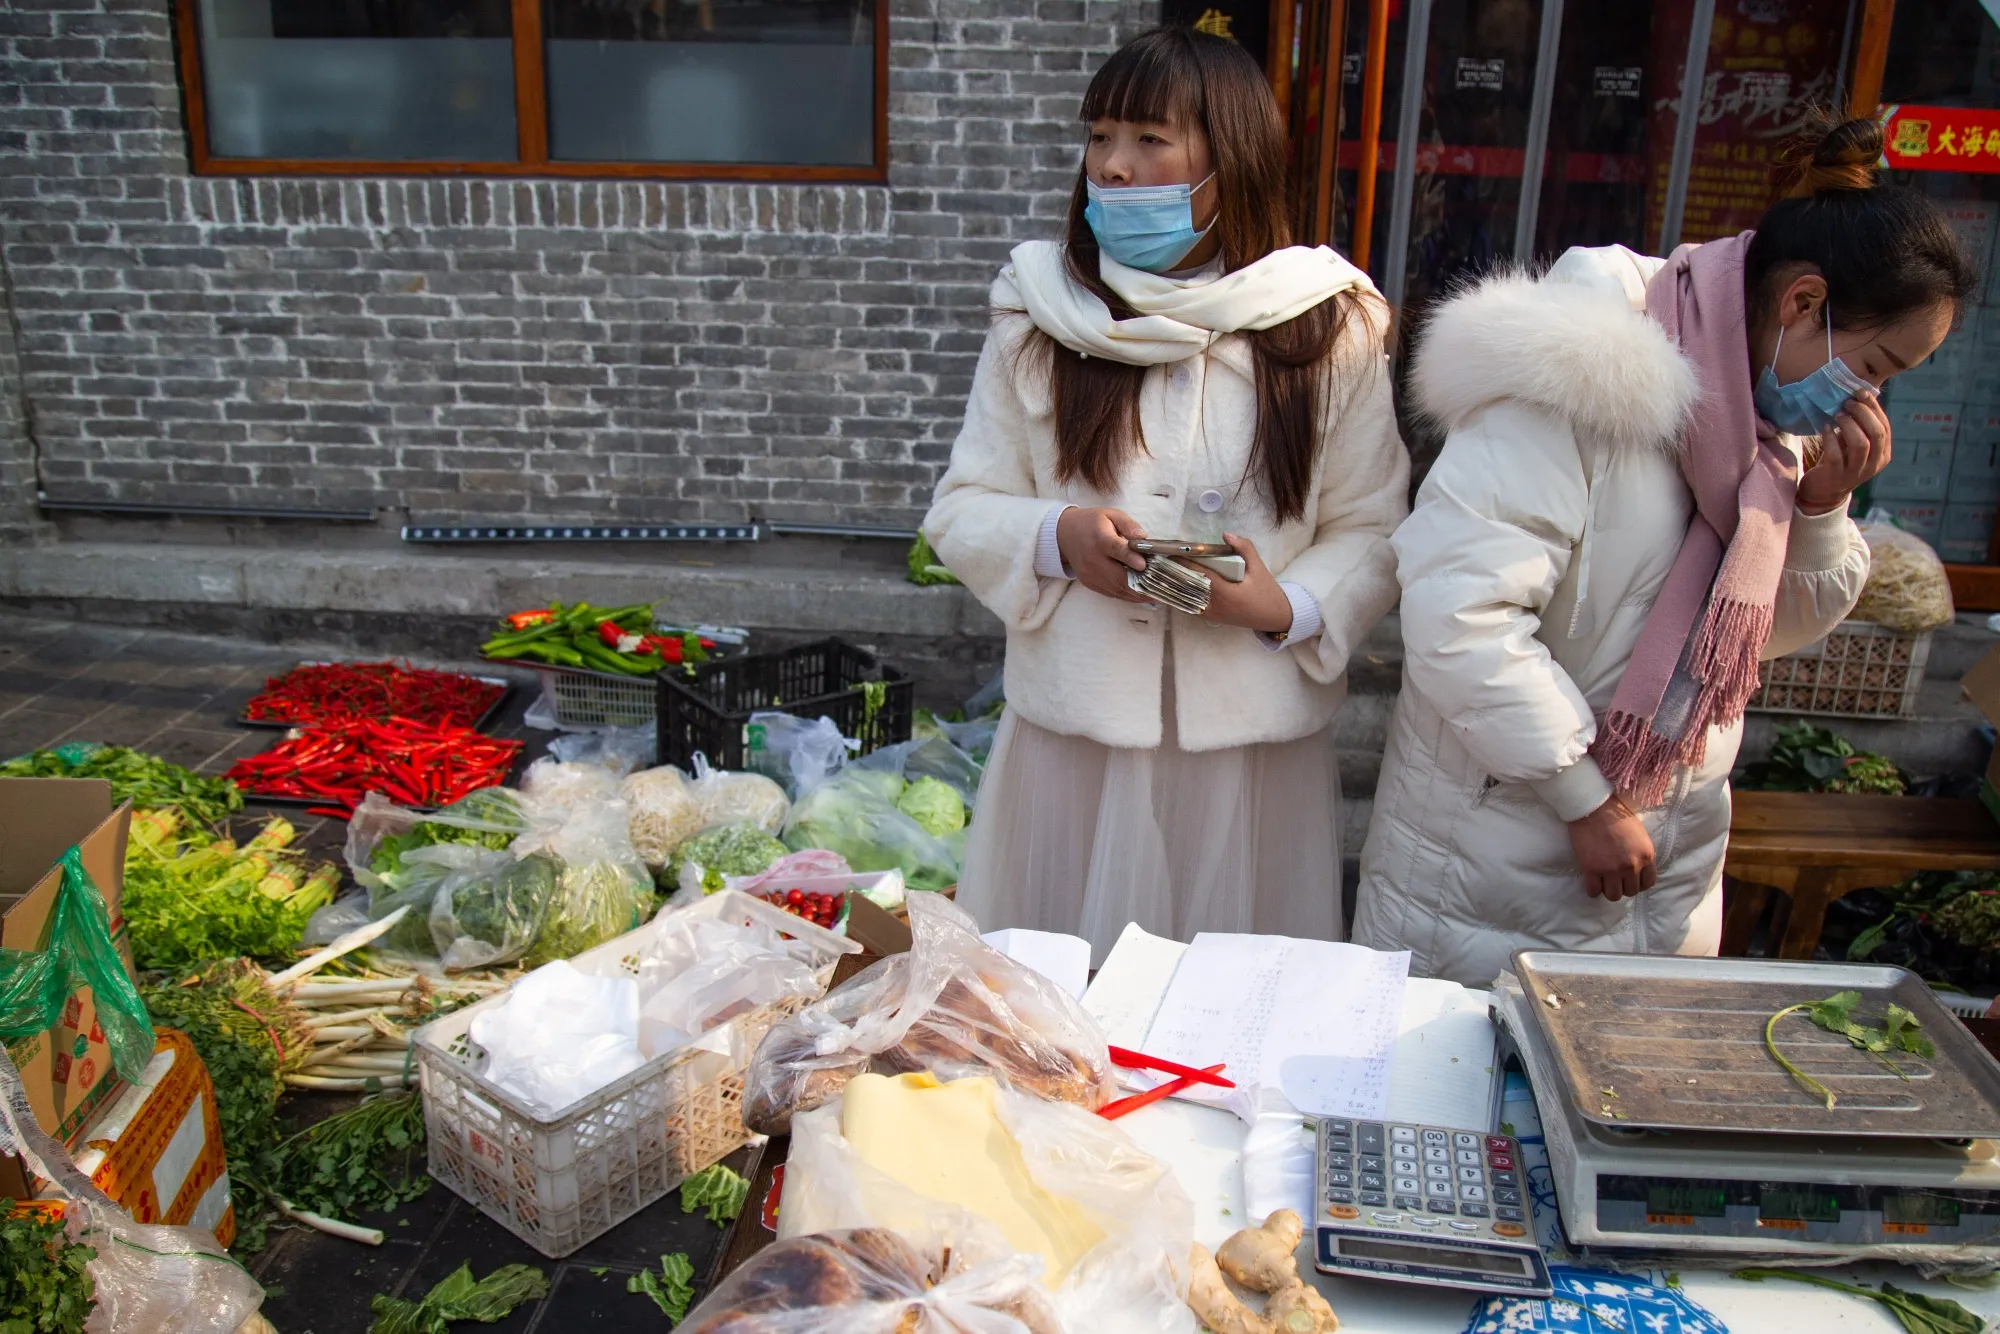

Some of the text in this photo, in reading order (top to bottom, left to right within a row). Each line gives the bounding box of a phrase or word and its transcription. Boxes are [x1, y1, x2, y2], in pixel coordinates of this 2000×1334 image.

[1427, 1132, 1443, 1141] 00
[1461, 1135, 1470, 1144] 0
[1492, 1139, 1507, 1147] AC
[1401, 1145, 1410, 1154] 3
[1433, 1149, 1441, 1158] 2
[1465, 1152, 1472, 1160] 1
[1495, 1157, 1510, 1165] CE
[1402, 1162, 1411, 1171] 6
[1434, 1166, 1443, 1174] 5
[1333, 1174, 1348, 1182] GT
[1466, 1169, 1475, 1178] 4
[1403, 1181, 1412, 1189] 9
[1436, 1183, 1445, 1192] 8
[1468, 1187, 1477, 1196] 7
